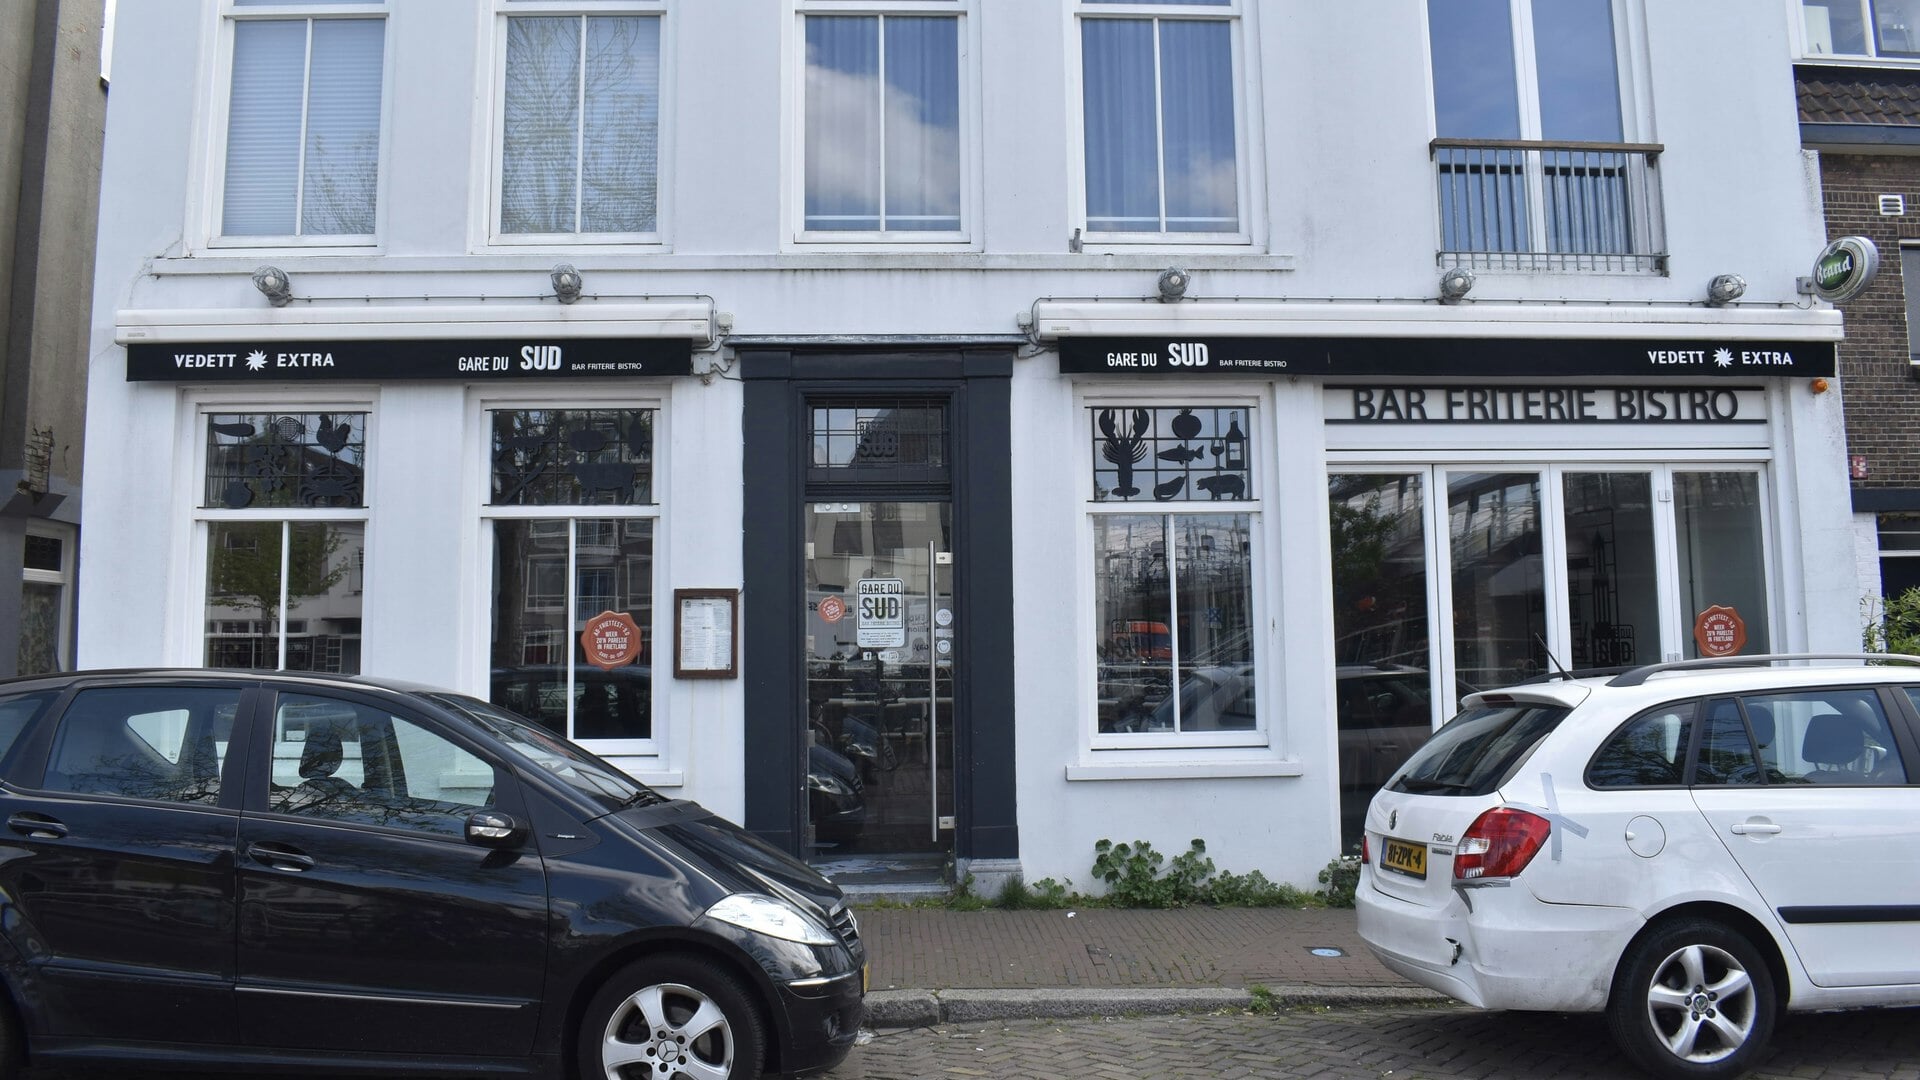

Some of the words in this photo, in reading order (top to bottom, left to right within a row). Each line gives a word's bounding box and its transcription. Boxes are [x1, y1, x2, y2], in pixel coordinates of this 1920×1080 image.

[1816, 254, 1852, 284] Brand
[174, 353, 237, 368] VEDETT
[276, 352, 335, 367] EXTRA
[458, 356, 490, 371] GARE
[492, 356, 509, 371] DU
[520, 345, 562, 371] SUD
[571, 363, 586, 371] BAR
[617, 362, 642, 370] BISTRO
[1107, 352, 1138, 367] GARE
[1141, 352, 1158, 367] DU
[1167, 342, 1209, 367] SUD
[1219, 359, 1233, 367] BAR
[1234, 359, 1262, 367] FRITERIE
[1263, 360, 1287, 368] BISTRO
[1647, 350, 1705, 365] VEDETT
[1741, 351, 1794, 366] EXTRA
[1353, 388, 1428, 421] BAR
[1447, 388, 1598, 421] FRITERIE
[1615, 388, 1738, 421] BISTRO
[861, 584, 885, 594] GARE
[887, 584, 899, 594] DU
[862, 597, 899, 620] SUD
[1387, 843, 1423, 869] 81-ZPK-4
